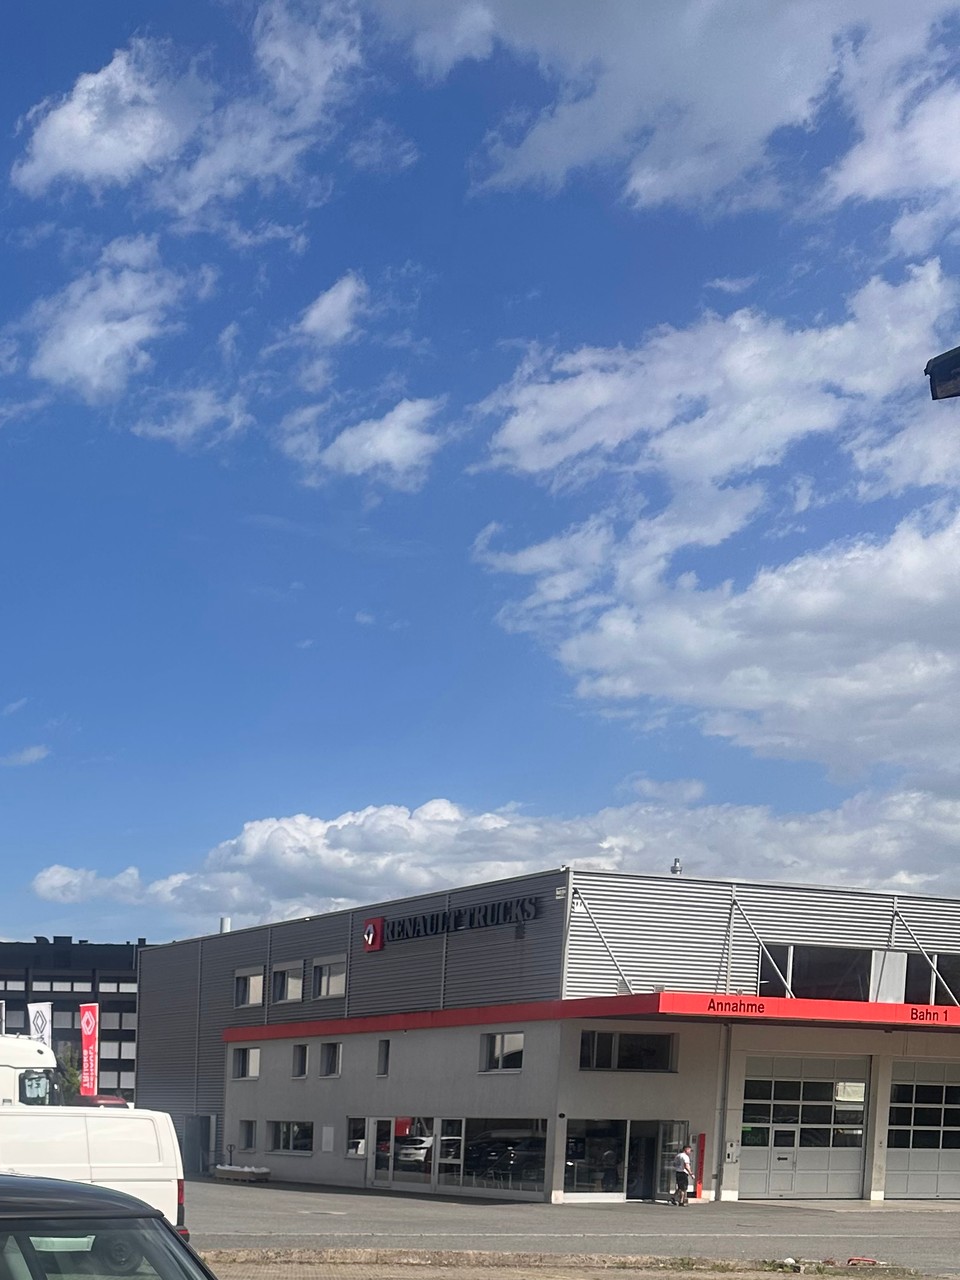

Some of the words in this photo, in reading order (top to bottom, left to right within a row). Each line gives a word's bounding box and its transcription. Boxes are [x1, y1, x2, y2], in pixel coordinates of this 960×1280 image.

[385, 911, 459, 942] RENAULT
[461, 897, 537, 929] TRUCKS
[707, 998, 765, 1013] Annahme
[910, 1008, 939, 1022] Bahn
[943, 1010, 948, 1022] 1
